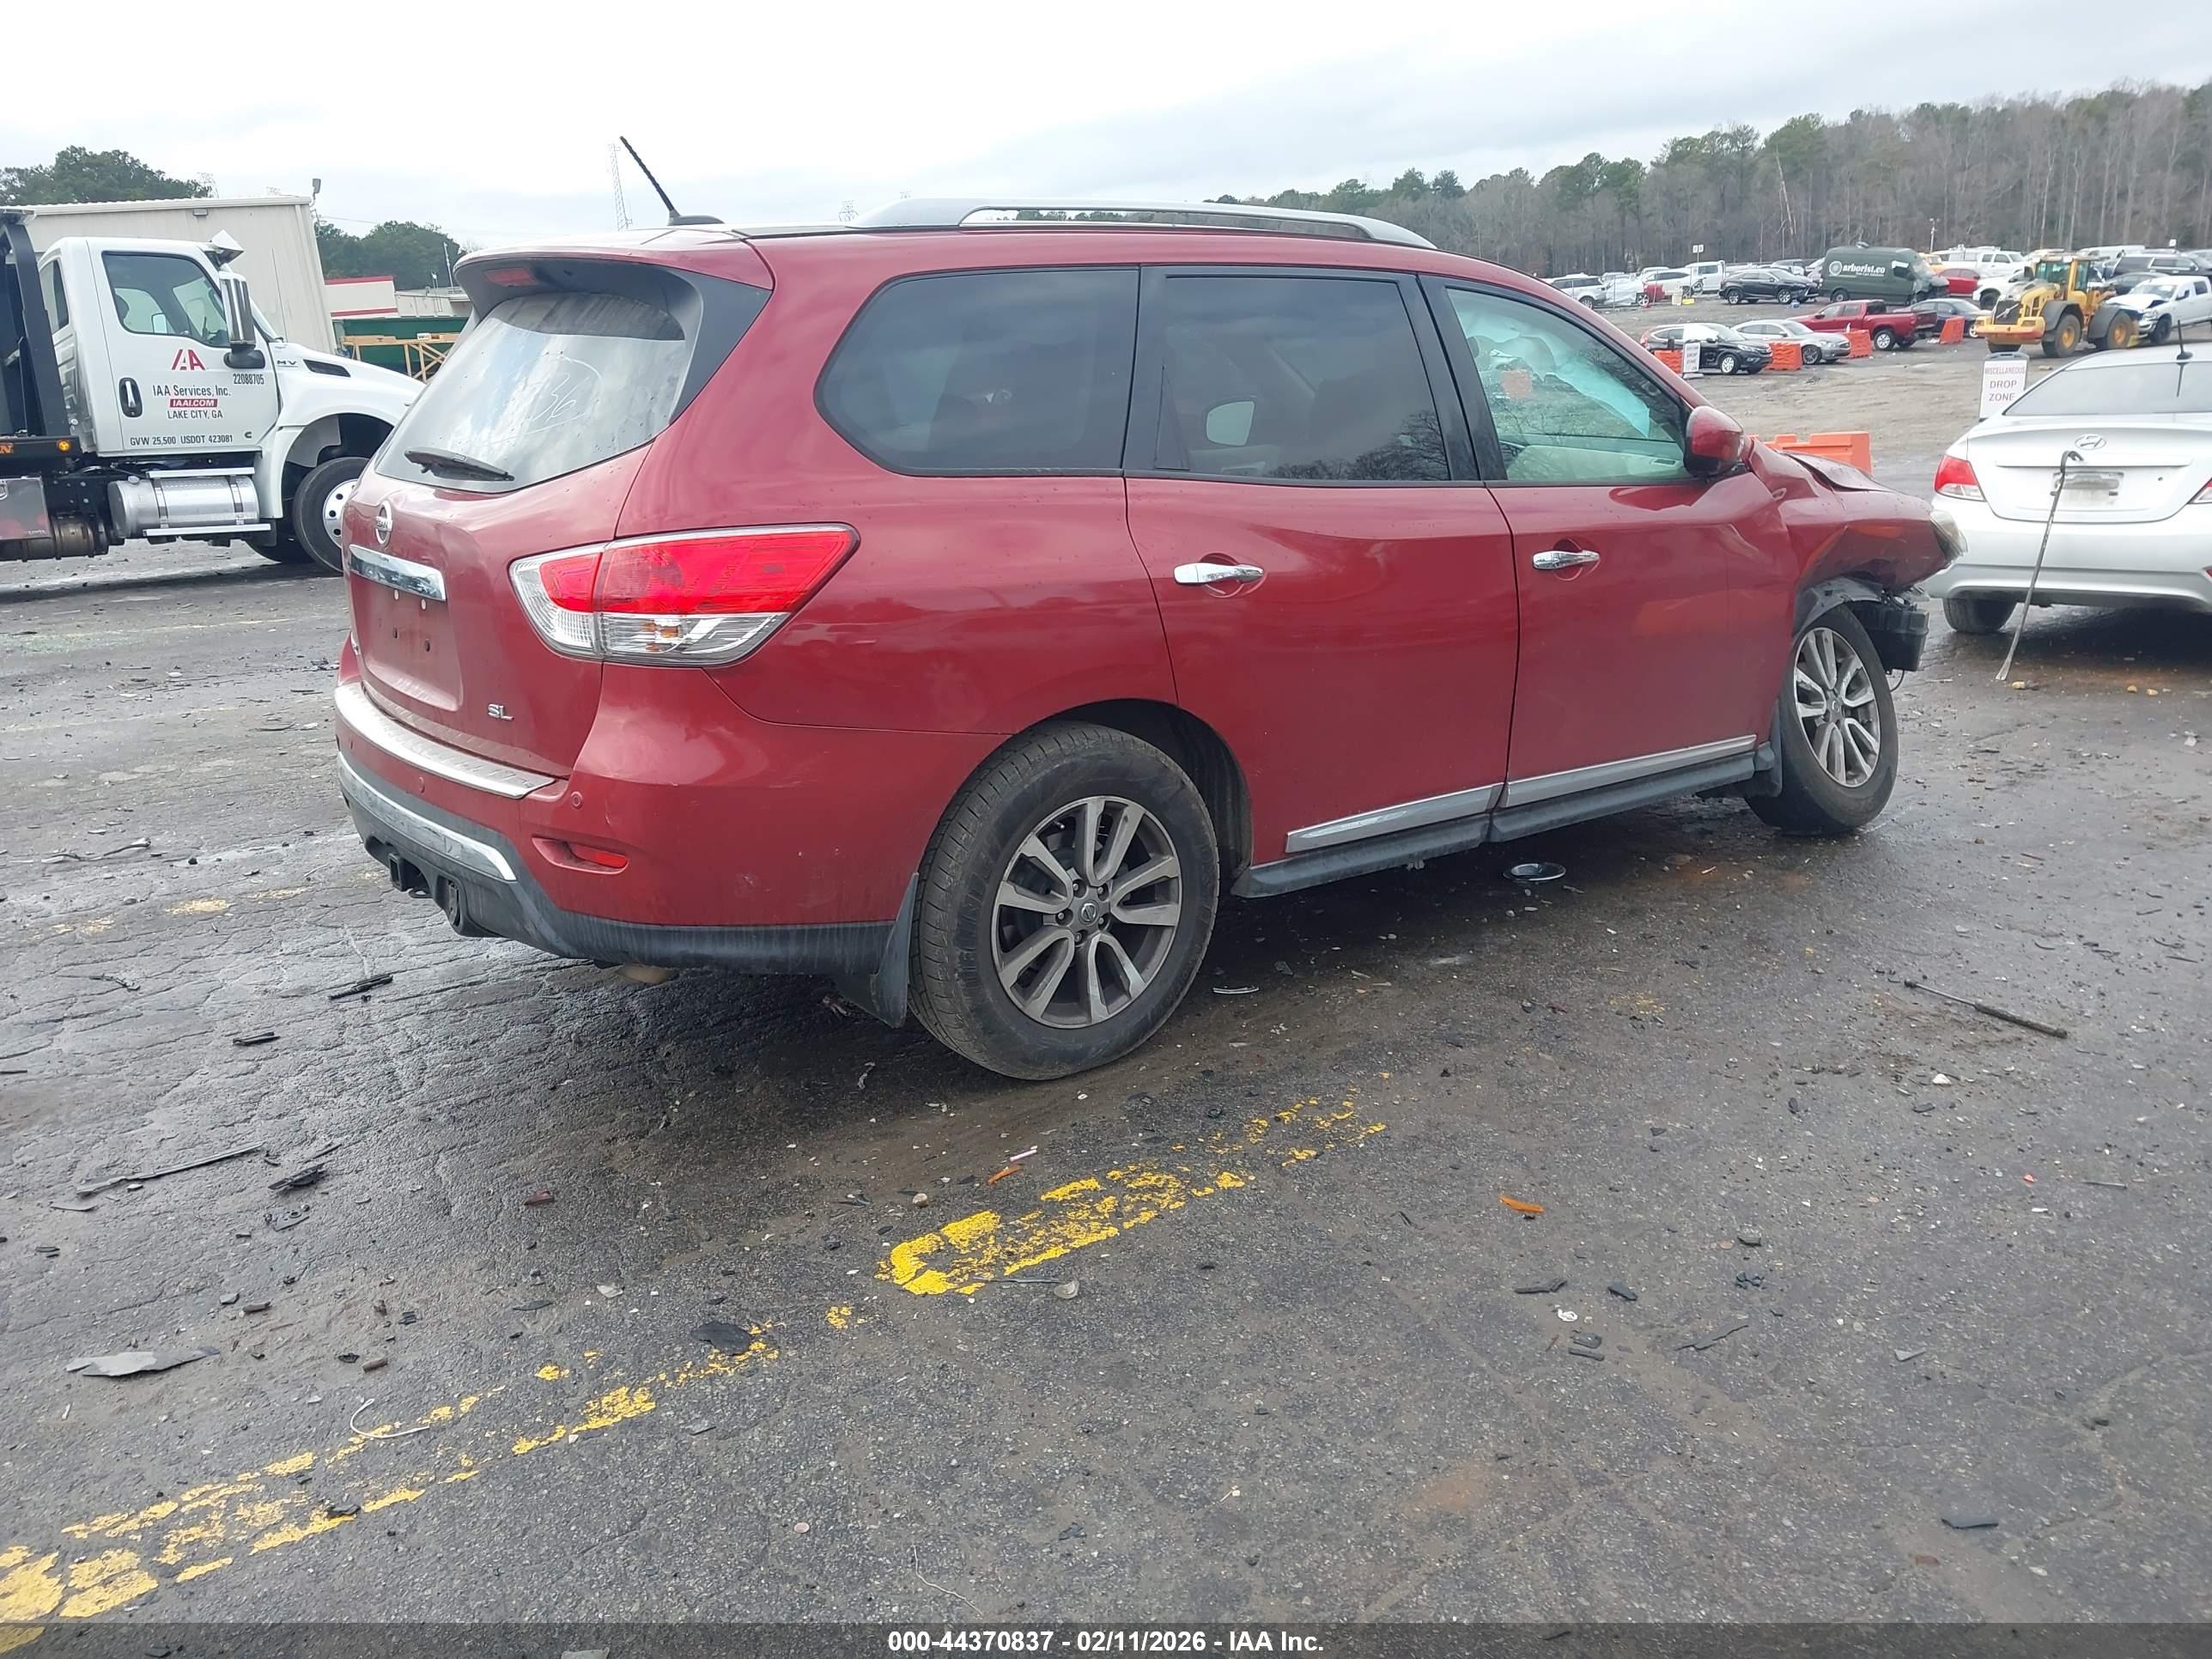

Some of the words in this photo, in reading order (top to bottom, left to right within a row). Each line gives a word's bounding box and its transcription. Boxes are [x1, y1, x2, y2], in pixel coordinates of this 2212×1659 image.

[1843, 263, 1886, 274] arborist.co
[234, 373, 264, 385] 22088705
[1990, 380, 2017, 389] DROP
[153, 384, 171, 396] IAA
[173, 384, 214, 398] Services,
[216, 385, 231, 396] Inc.
[1989, 392, 2016, 402] ZONE
[167, 410, 188, 419] LAKE
[191, 410, 210, 419] CITY,
[211, 410, 222, 418] GA
[130, 436, 149, 446] GVW
[152, 436, 176, 446] 25,500
[180, 435, 205, 445] USDOT
[208, 434, 233, 443] 423081
[488, 703, 514, 720] SL
